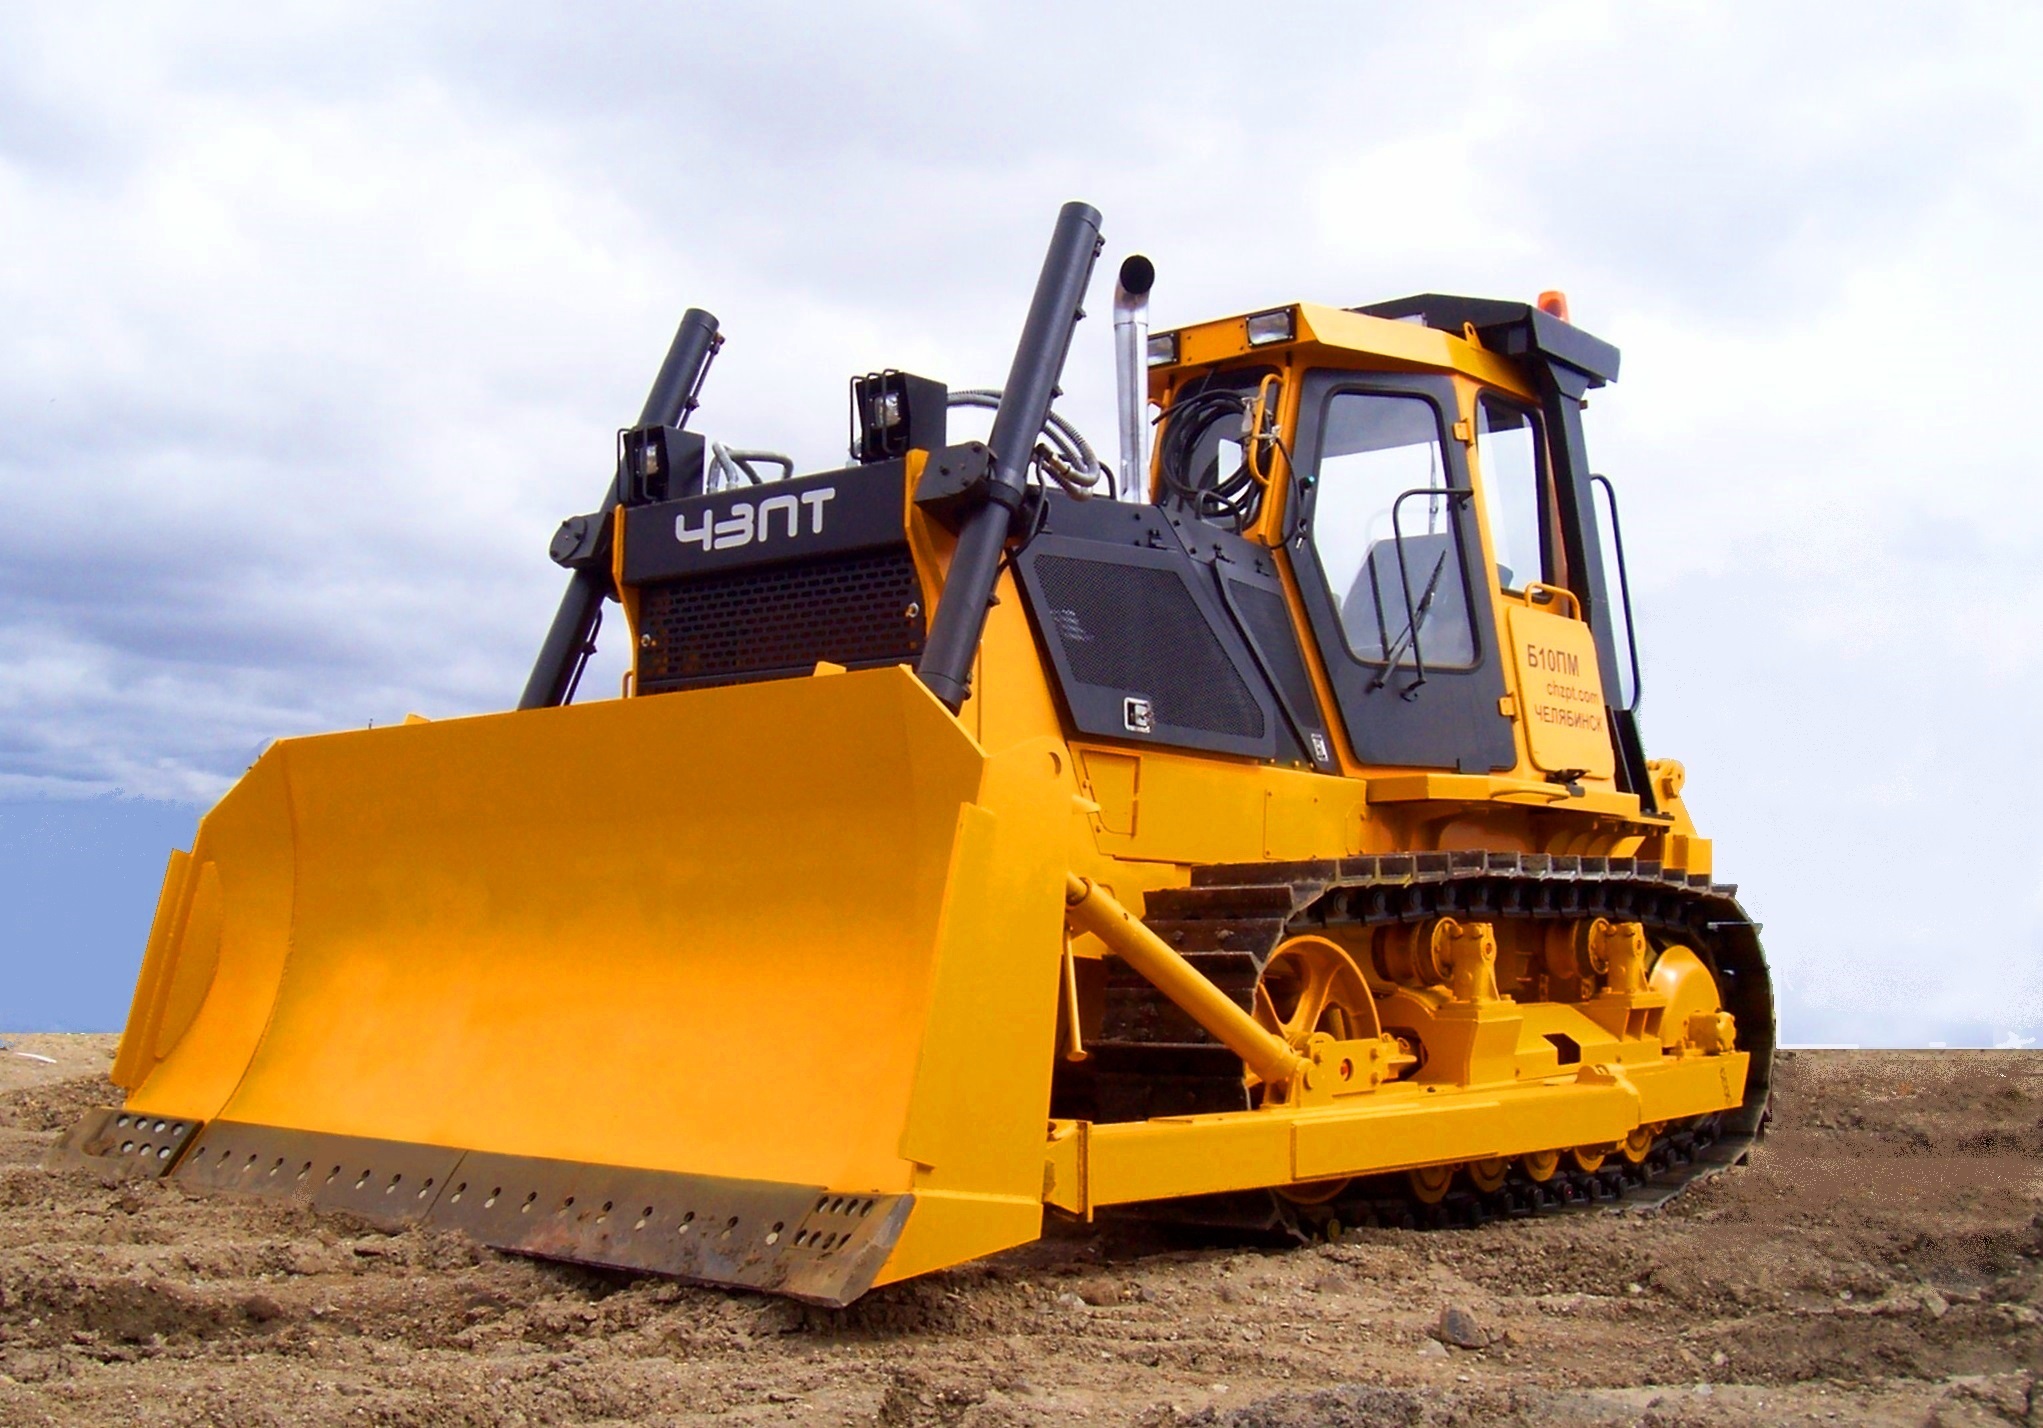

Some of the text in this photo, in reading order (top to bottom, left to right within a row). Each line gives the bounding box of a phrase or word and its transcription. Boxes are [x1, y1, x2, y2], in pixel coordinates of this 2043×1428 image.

[675, 487, 836, 551] ЧЗПТ
[1527, 644, 1579, 677] Б10ПМ
[1546, 680, 1600, 704] chzpt.com
[1534, 704, 1603, 732] ЧЕЛЯБИНСК
